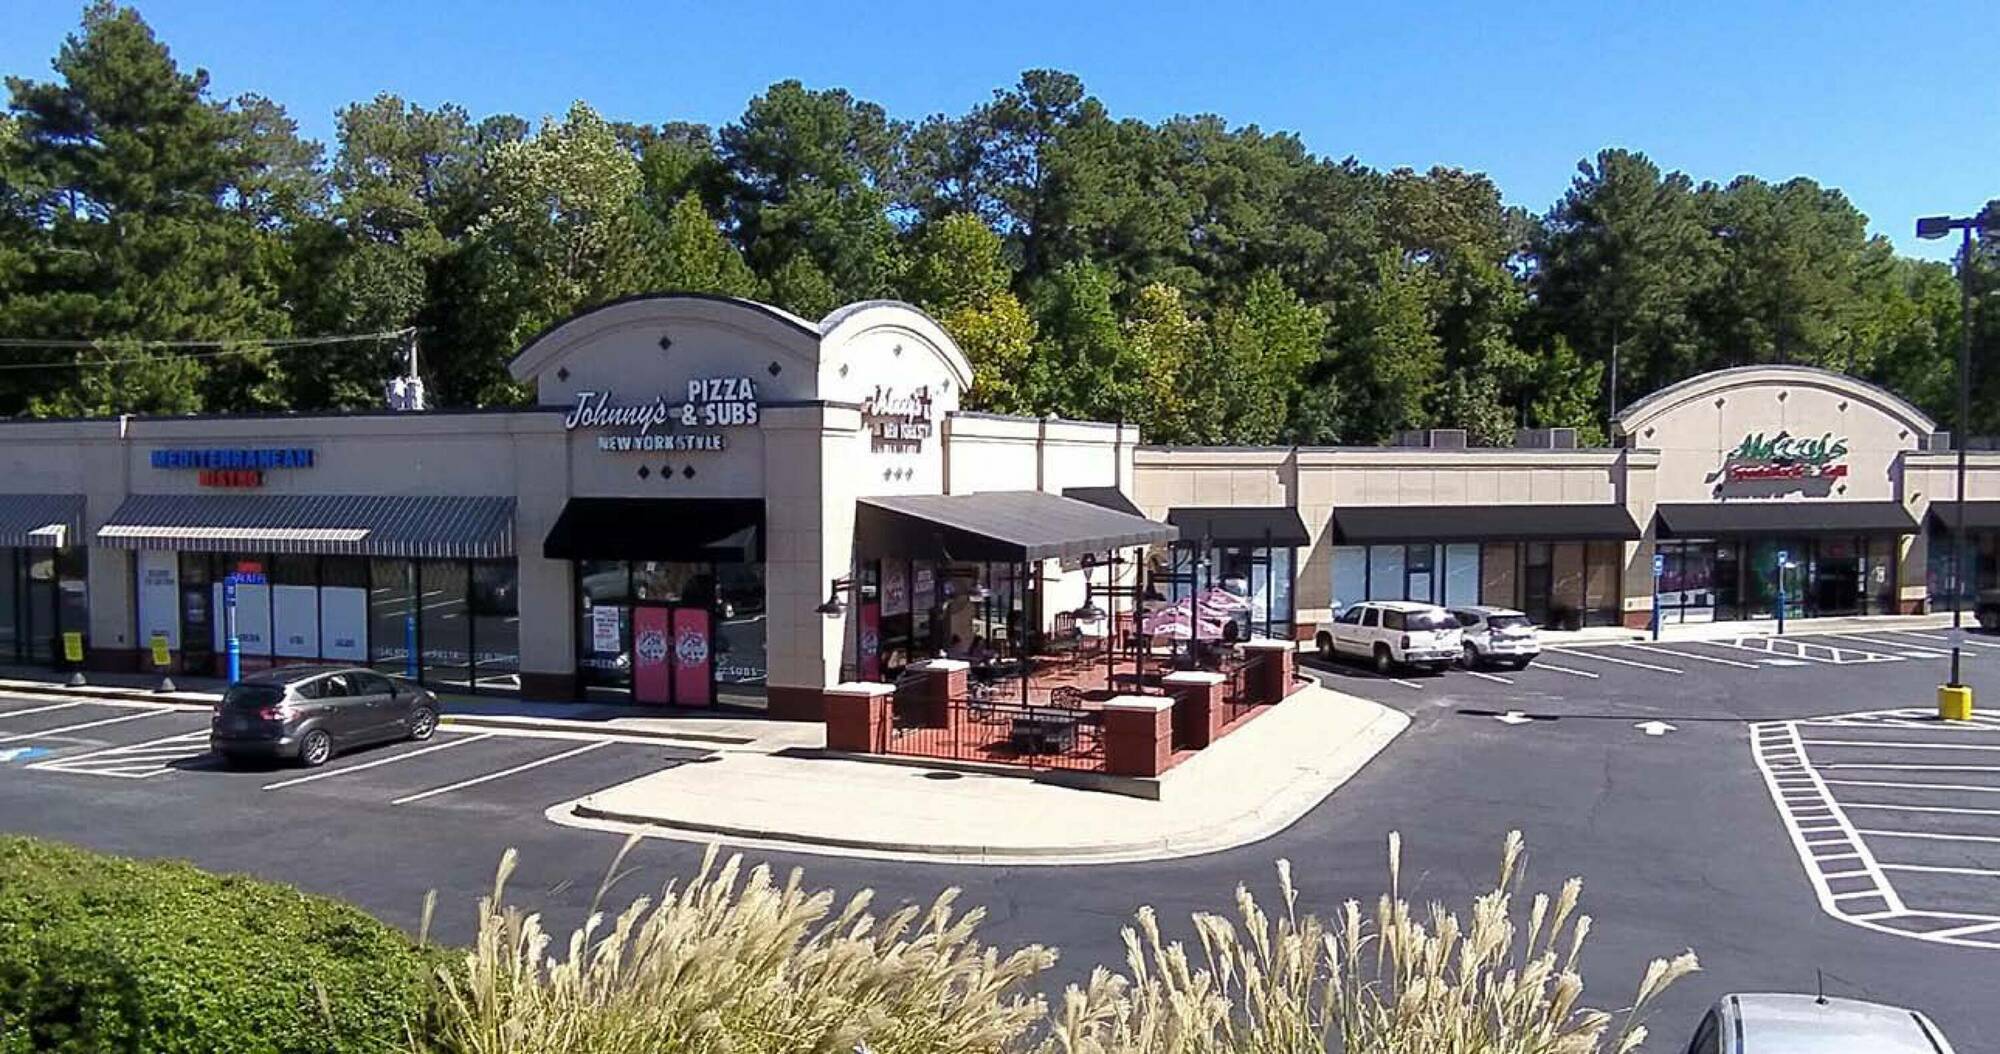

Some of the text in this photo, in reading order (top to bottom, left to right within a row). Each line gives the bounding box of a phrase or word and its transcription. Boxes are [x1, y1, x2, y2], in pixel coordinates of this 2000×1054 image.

[688, 378, 754, 401] PIZZA
[565, 391, 668, 435] Johnny's
[681, 402, 758, 426] & SUBS
[598, 435, 724, 450] NEW YORK STYLE
[150, 449, 315, 468] MEDITERRANEAN
